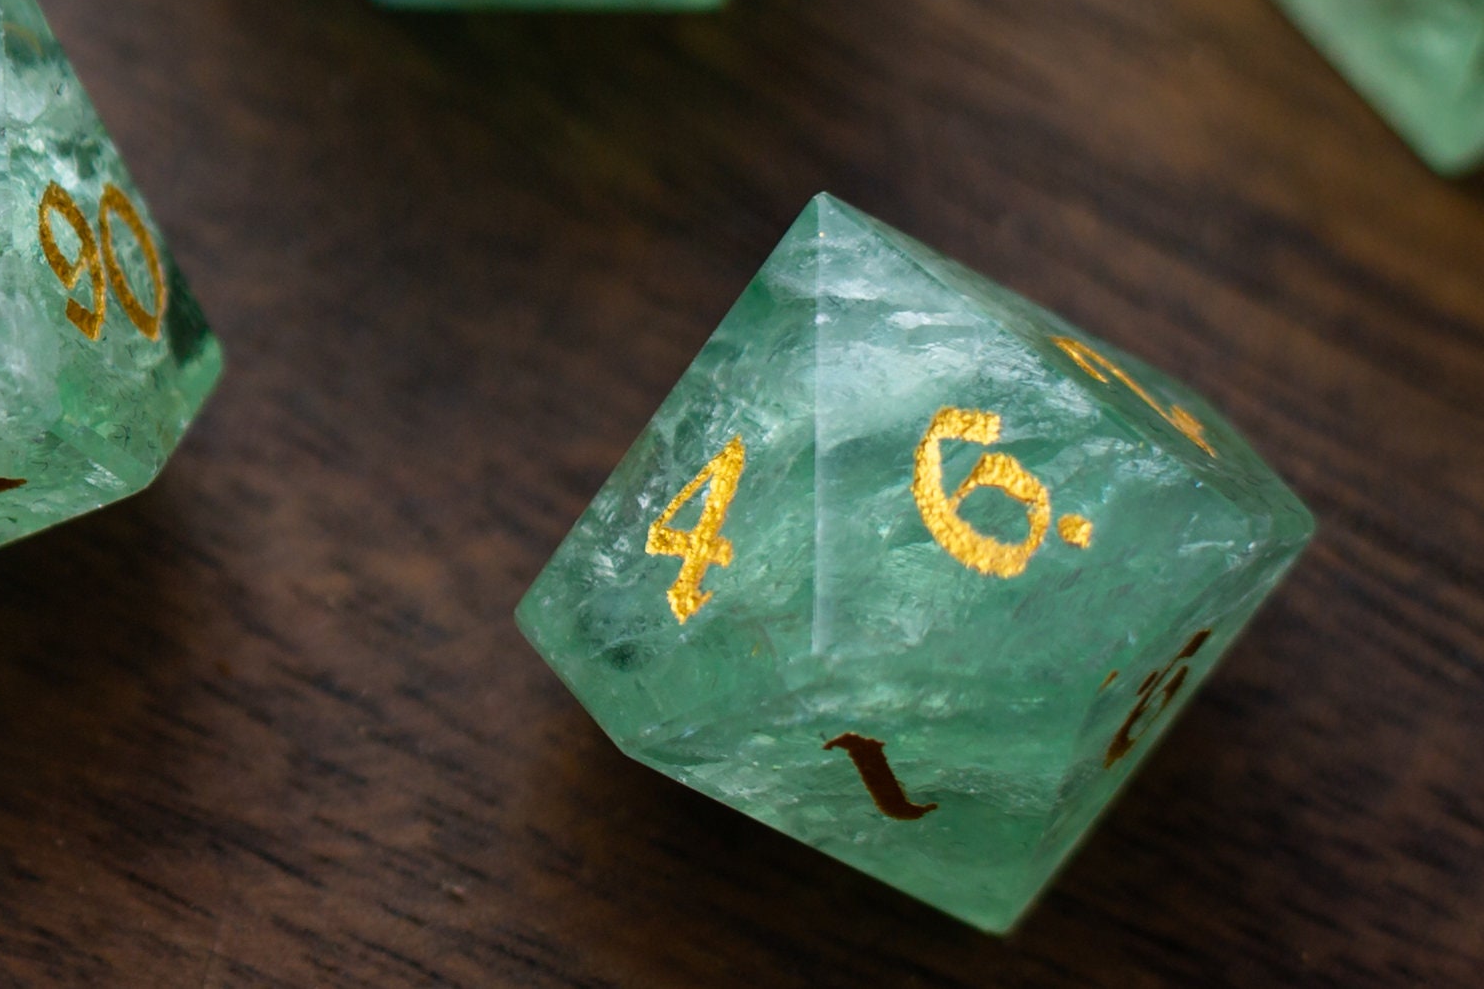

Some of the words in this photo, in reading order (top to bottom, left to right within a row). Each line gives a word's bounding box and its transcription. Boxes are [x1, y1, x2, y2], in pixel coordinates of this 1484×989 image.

[38, 180, 167, 342] 90
[646, 435, 746, 624] 4
[822, 730, 938, 822] 1
